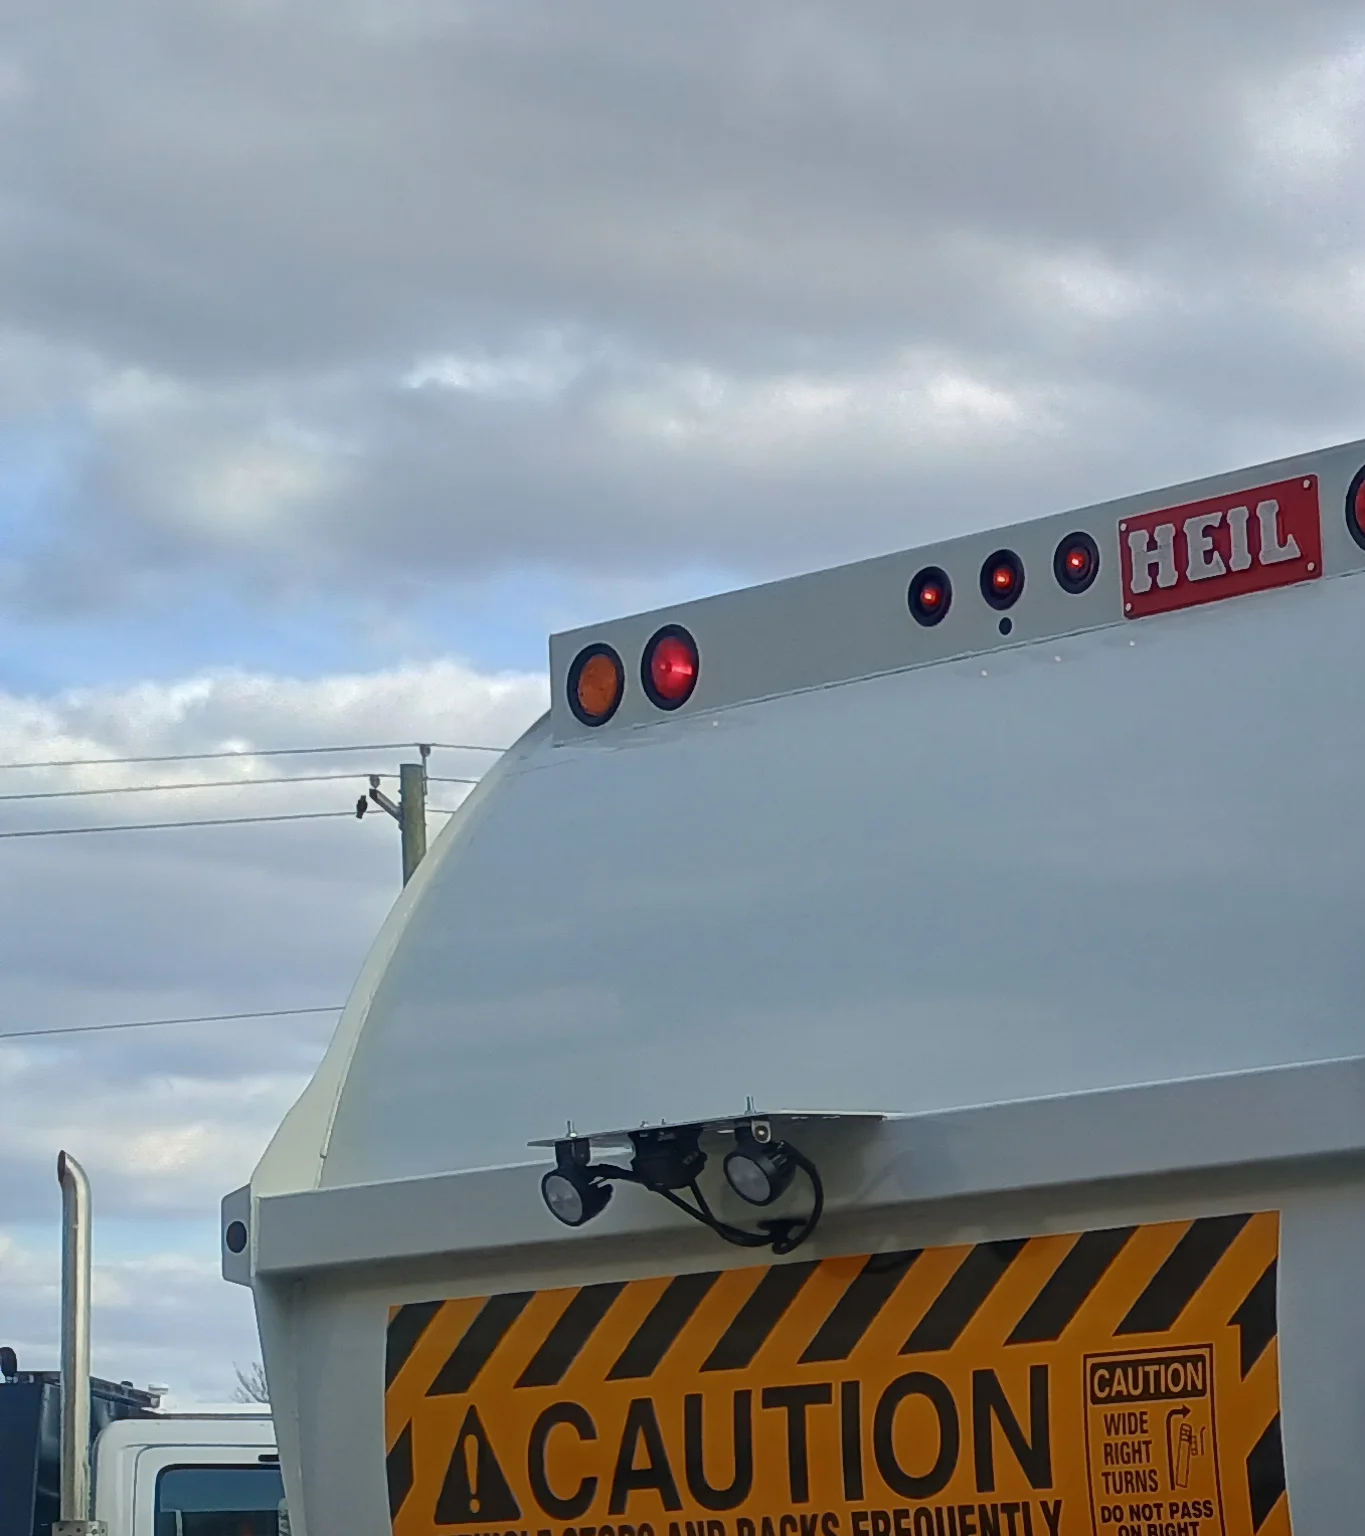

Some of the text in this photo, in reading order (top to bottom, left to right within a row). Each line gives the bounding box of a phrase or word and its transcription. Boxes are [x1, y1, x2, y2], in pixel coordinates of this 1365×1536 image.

[1128, 499, 1301, 594] HEIL
[1094, 1361, 1203, 1399] CAUTION
[1104, 1410, 1149, 1437] WIDE
[527, 1363, 1053, 1520] CAUTION
[1103, 1440, 1153, 1466] RIGHT
[1101, 1469, 1159, 1495] TURNS
[1101, 1499, 1214, 1524] DO NOT PASS
